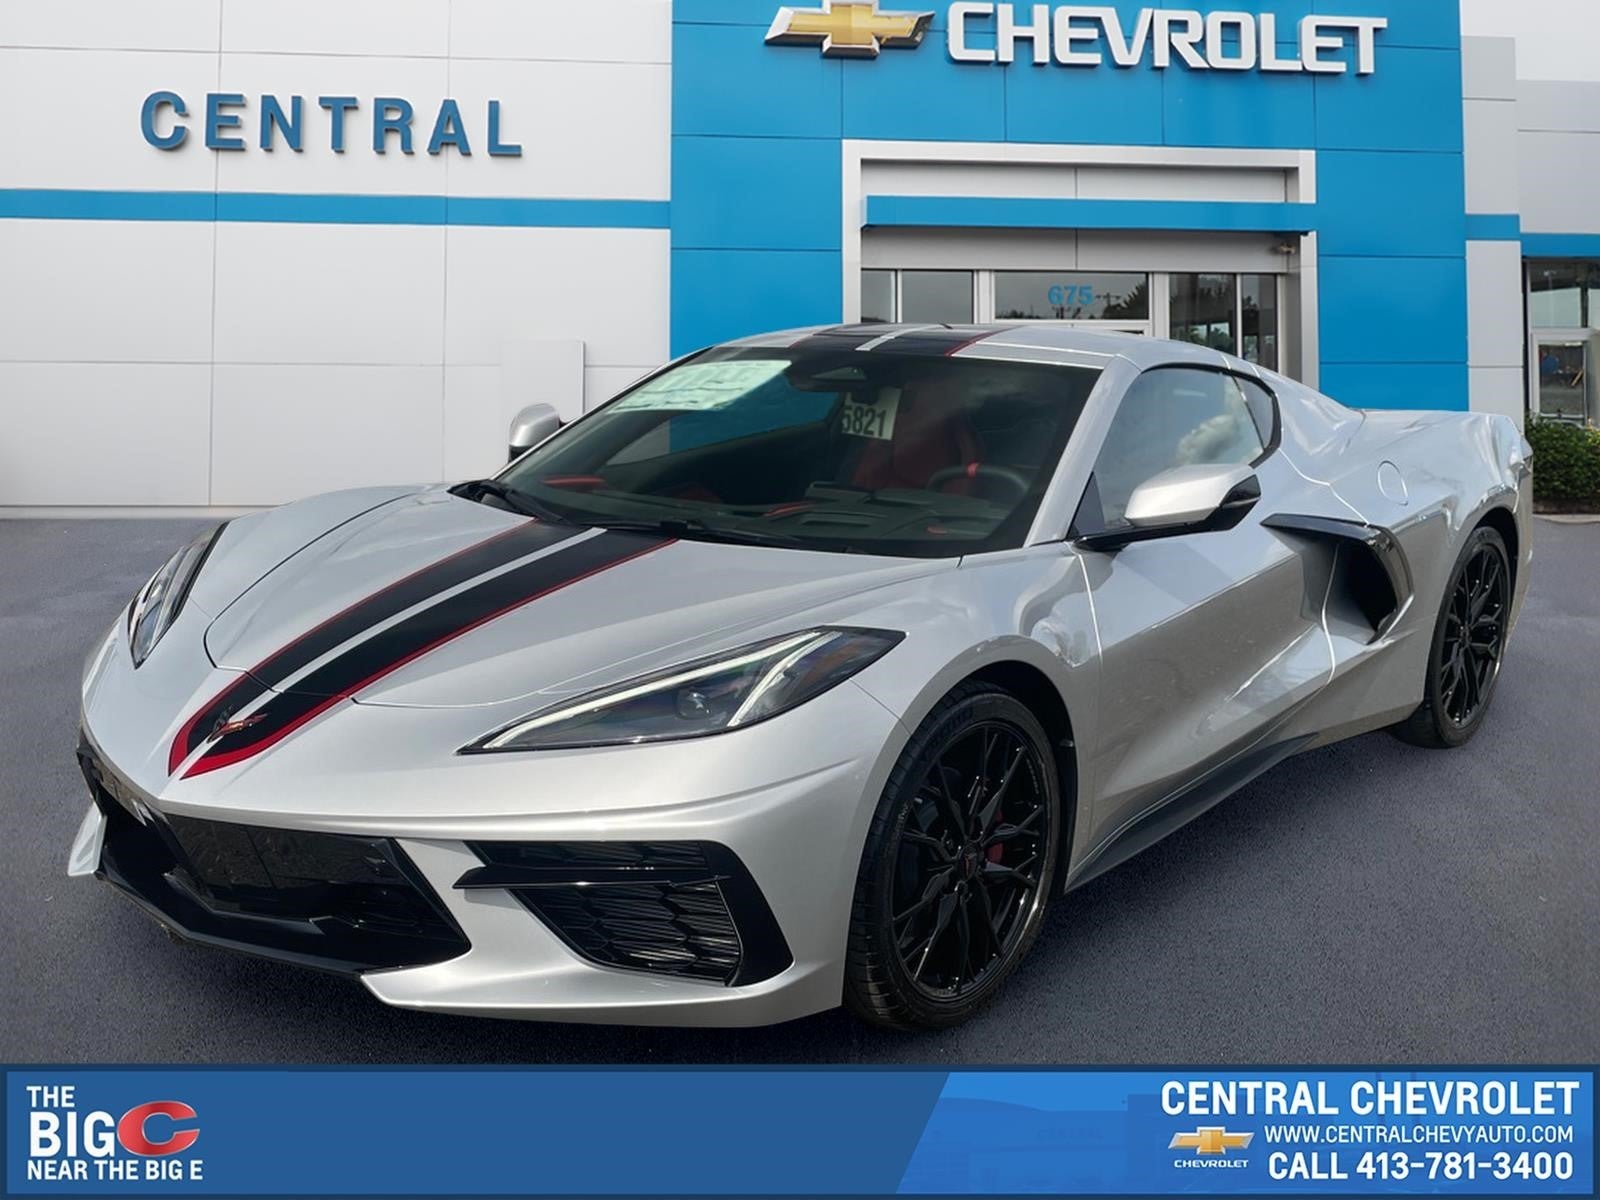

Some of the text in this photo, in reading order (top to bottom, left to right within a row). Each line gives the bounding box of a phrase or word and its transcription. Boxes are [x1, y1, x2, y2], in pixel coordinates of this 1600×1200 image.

[948, 2, 1387, 75] CHEVROLET
[141, 91, 523, 156] CENTRAL
[1048, 284, 1093, 304] 675
[841, 405, 887, 437] 5821
